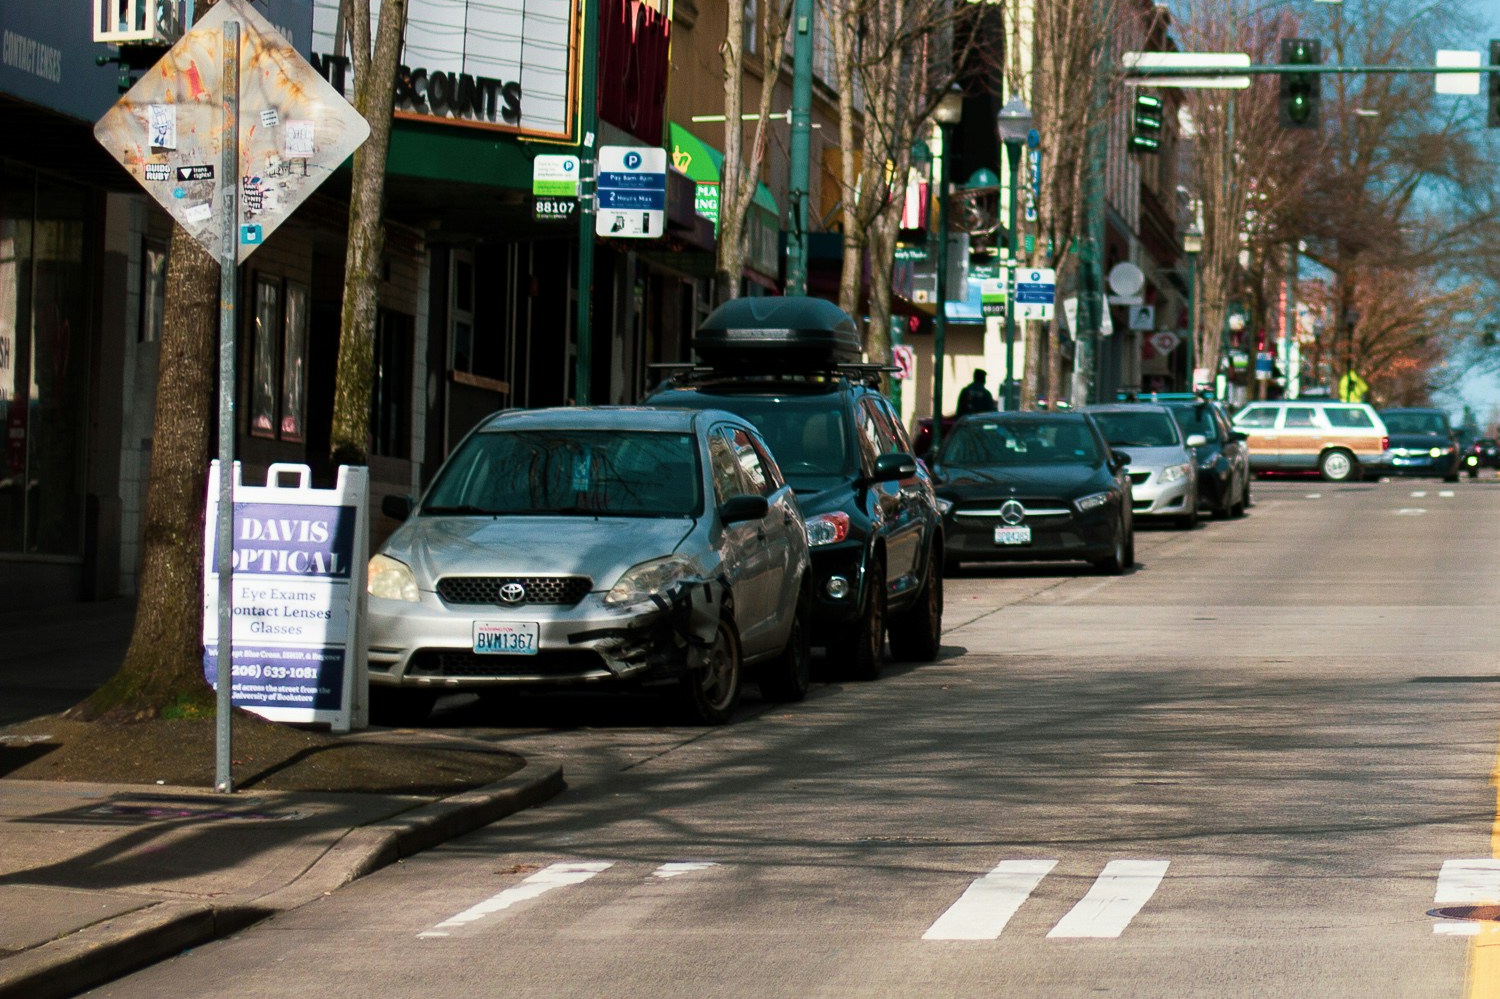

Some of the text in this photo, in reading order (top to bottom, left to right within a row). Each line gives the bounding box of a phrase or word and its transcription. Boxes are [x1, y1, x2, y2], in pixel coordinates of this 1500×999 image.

[3, 29, 62, 84] CONTACT LENSES
[394, 65, 522, 123] SCOUNTS
[146, 164, 171, 173] GUIDO
[146, 172, 170, 180] RUBY
[610, 174, 621, 182] Pay
[609, 192, 616, 201] 2
[696, 186, 717, 196] MA
[536, 201, 575, 214] 88107
[239, 517, 329, 544] DAVIS
[242, 587, 317, 601] Eye Exams
[234, 605, 332, 619] ontact Lenses
[250, 621, 303, 635] Glasses
[478, 632, 534, 650] BVM1367
[231, 664, 318, 679] 206) 633-1081
